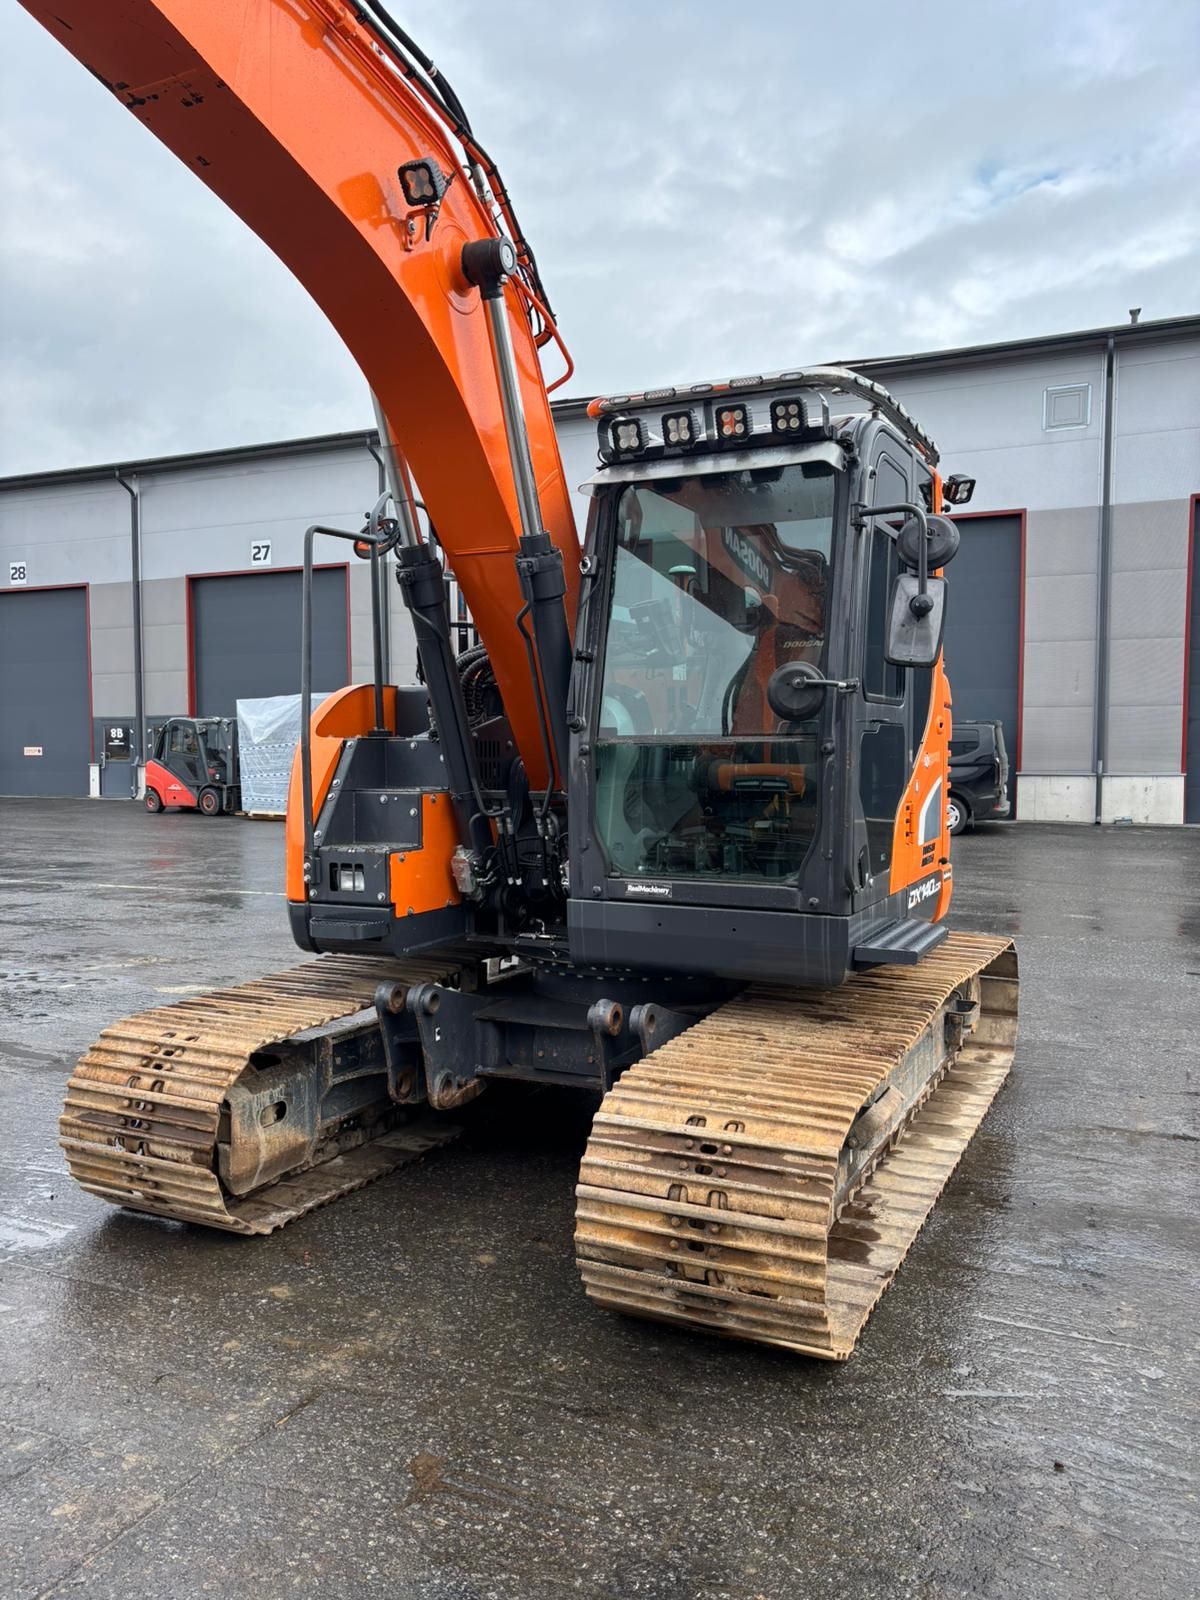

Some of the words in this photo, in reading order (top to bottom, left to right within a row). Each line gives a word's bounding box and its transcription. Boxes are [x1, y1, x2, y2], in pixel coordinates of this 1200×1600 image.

[252, 545, 271, 561] 27
[10, 566, 26, 580] 28
[110, 728, 124, 738] 8B
